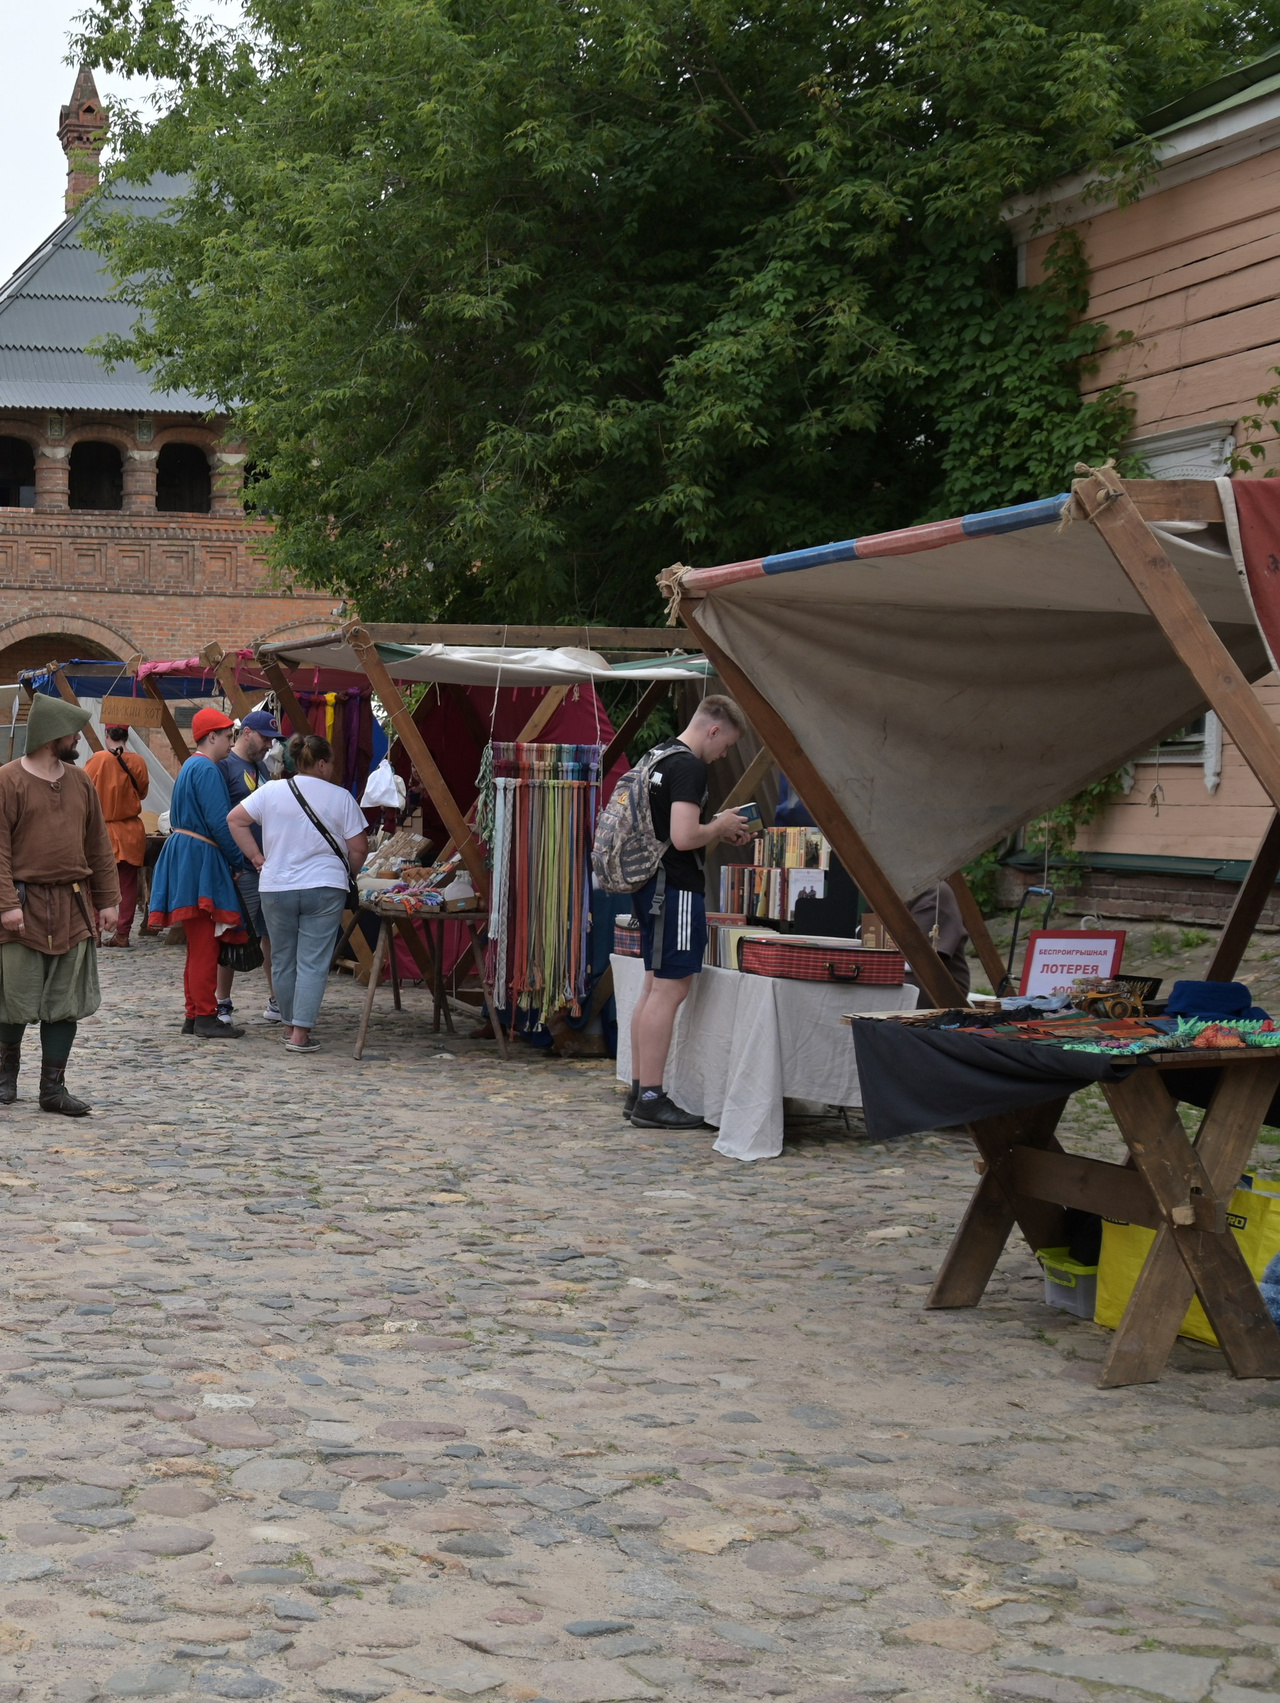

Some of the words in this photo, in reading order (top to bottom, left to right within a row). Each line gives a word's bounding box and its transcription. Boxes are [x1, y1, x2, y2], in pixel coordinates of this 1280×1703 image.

[145, 707, 161, 719] КОТ
[1039, 948, 1108, 956] БЕСПРОИГРЫШНАЯ
[1040, 964, 1099, 975] ЛОТЕРЕЯ
